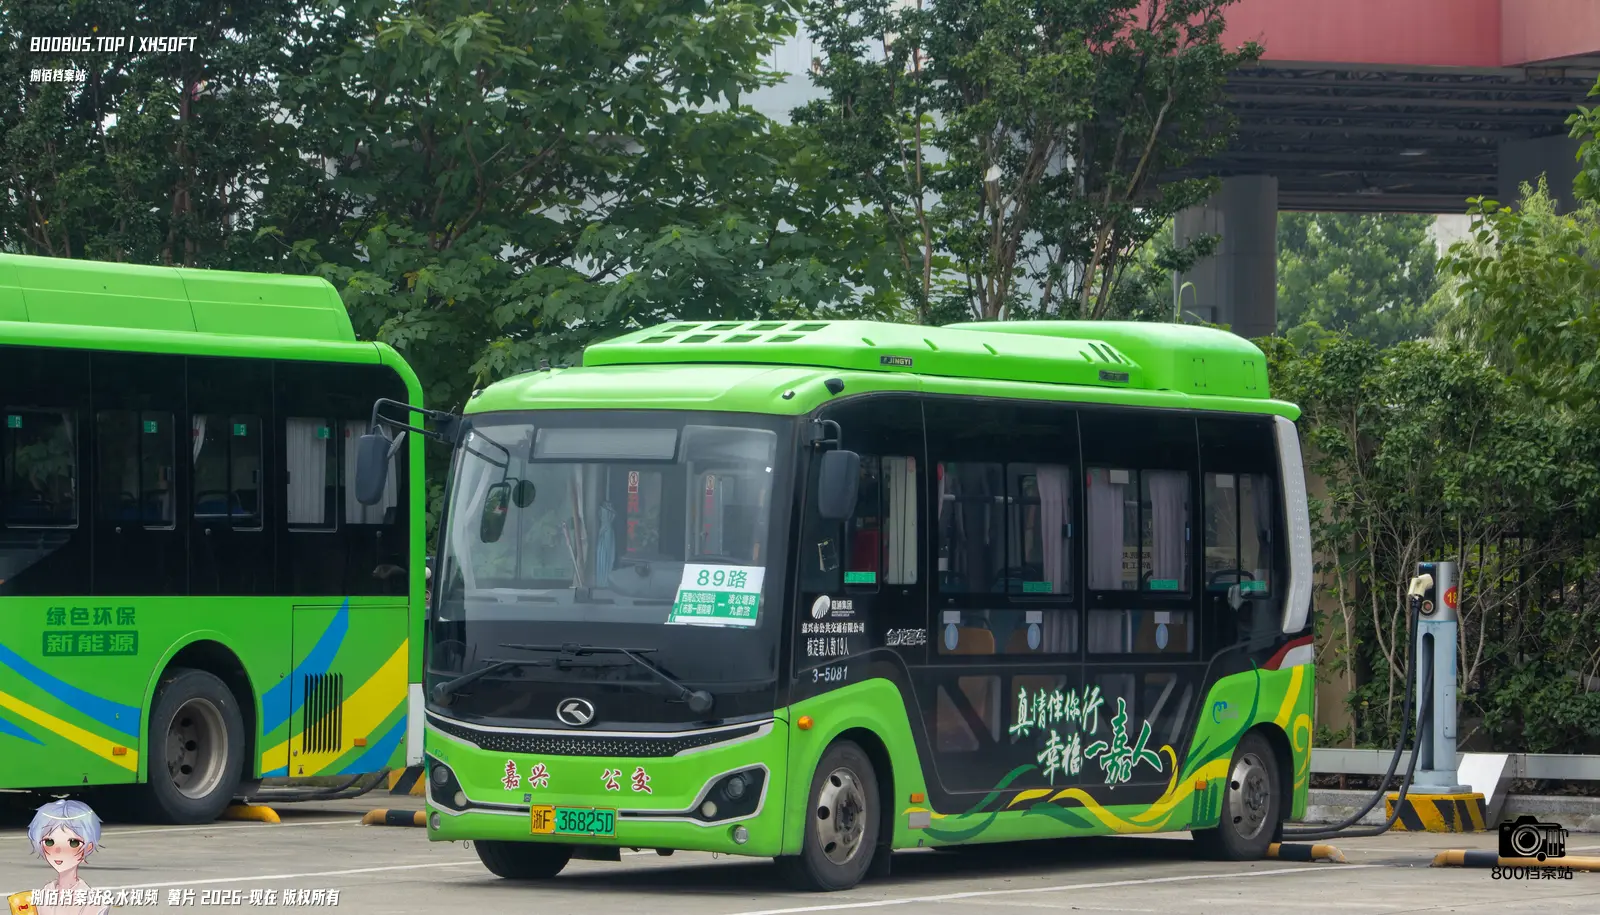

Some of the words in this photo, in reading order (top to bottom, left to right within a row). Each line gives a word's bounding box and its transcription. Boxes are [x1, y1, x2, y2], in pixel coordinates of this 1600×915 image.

[697, 570, 748, 588] 89路
[46, 606, 136, 626] 绿色环保
[801, 622, 865, 634] 嘉兴市公共交通有限公司
[886, 628, 926, 646] 金龙客车
[46, 634, 134, 653] 新能源
[806, 637, 850, 657] 核定载人数19人
[812, 666, 848, 683] 3-5081
[1008, 684, 1105, 737] 真情伴你行
[501, 758, 550, 791] 嘉兴
[600, 766, 653, 795] 公交
[532, 810, 552, 830] 浙F
[558, 810, 614, 833] 36825D
